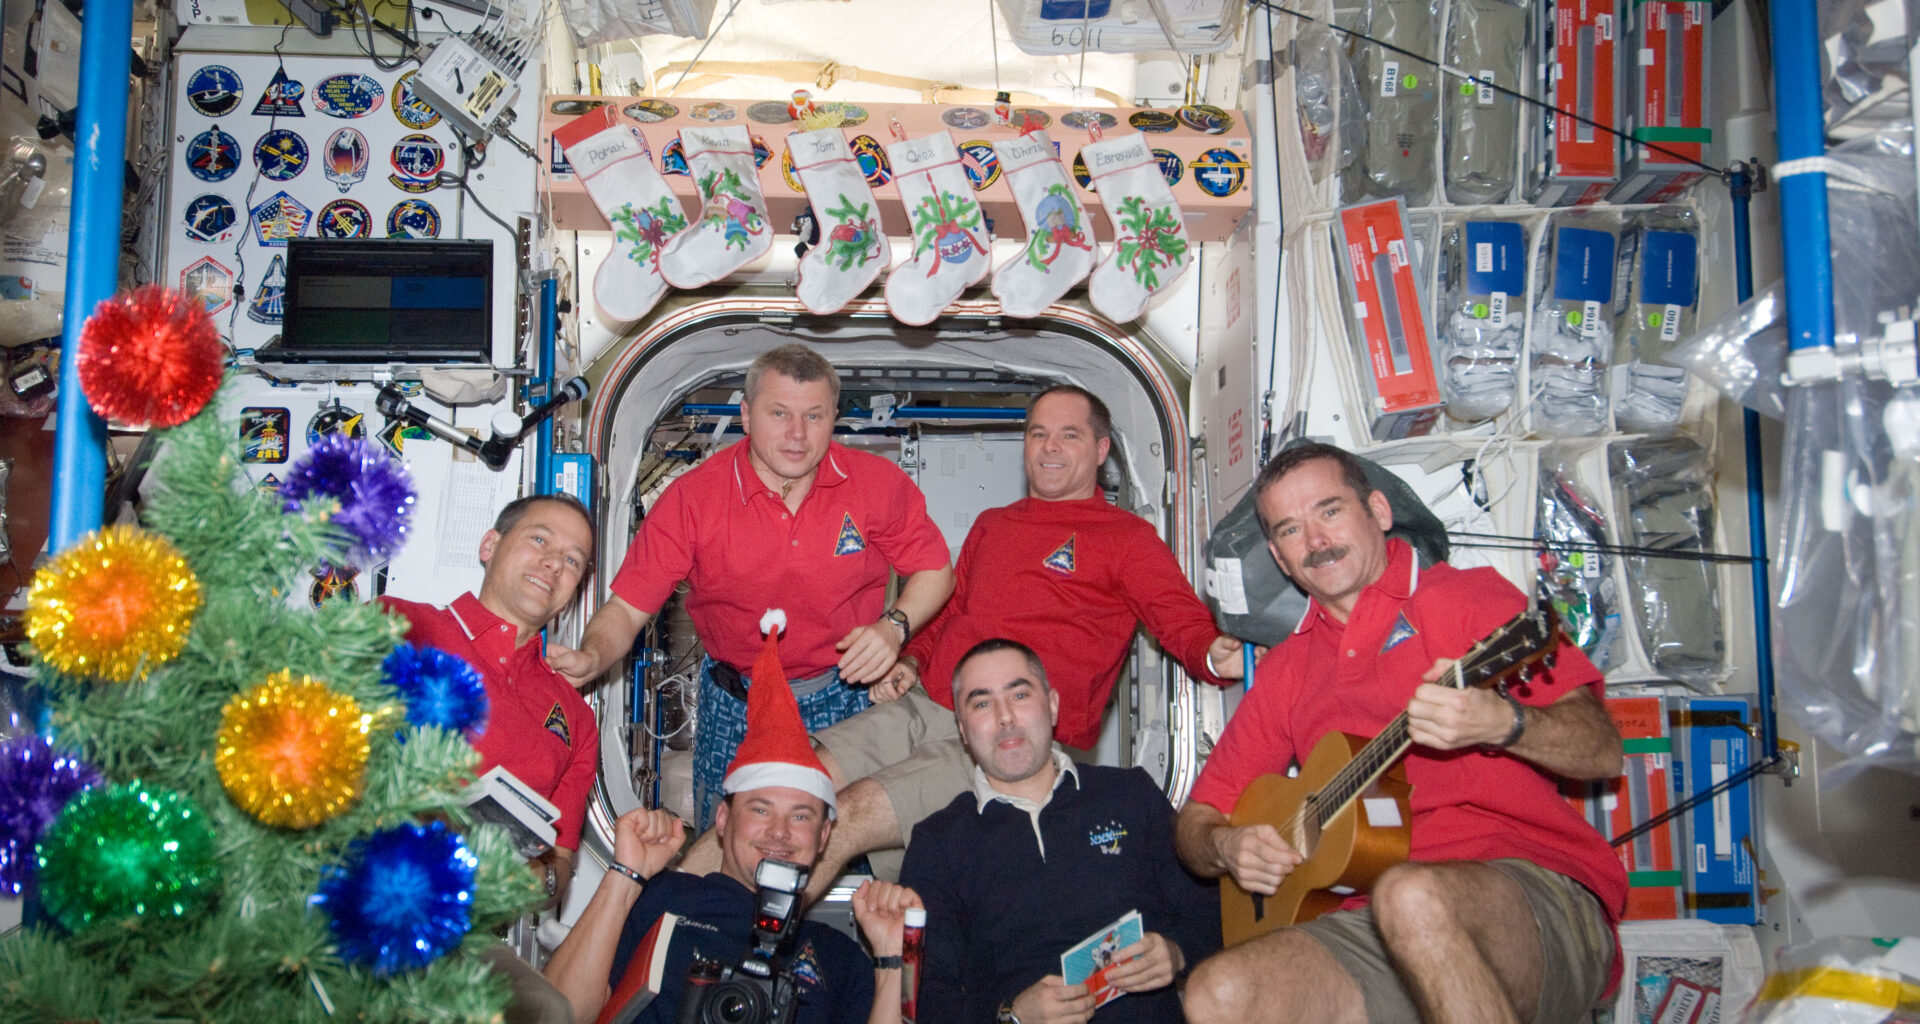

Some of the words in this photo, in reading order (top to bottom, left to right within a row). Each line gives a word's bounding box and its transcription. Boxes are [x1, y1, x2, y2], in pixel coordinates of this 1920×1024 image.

[1385, 67, 1396, 93] B168
[811, 141, 836, 153] Tom
[1011, 144, 1046, 160] Chris
[1493, 298, 1503, 324] B162
[1586, 307, 1596, 332] B164
[1665, 309, 1677, 336] B160
[675, 915, 719, 933] Roman
[742, 960, 767, 973] Nikon
